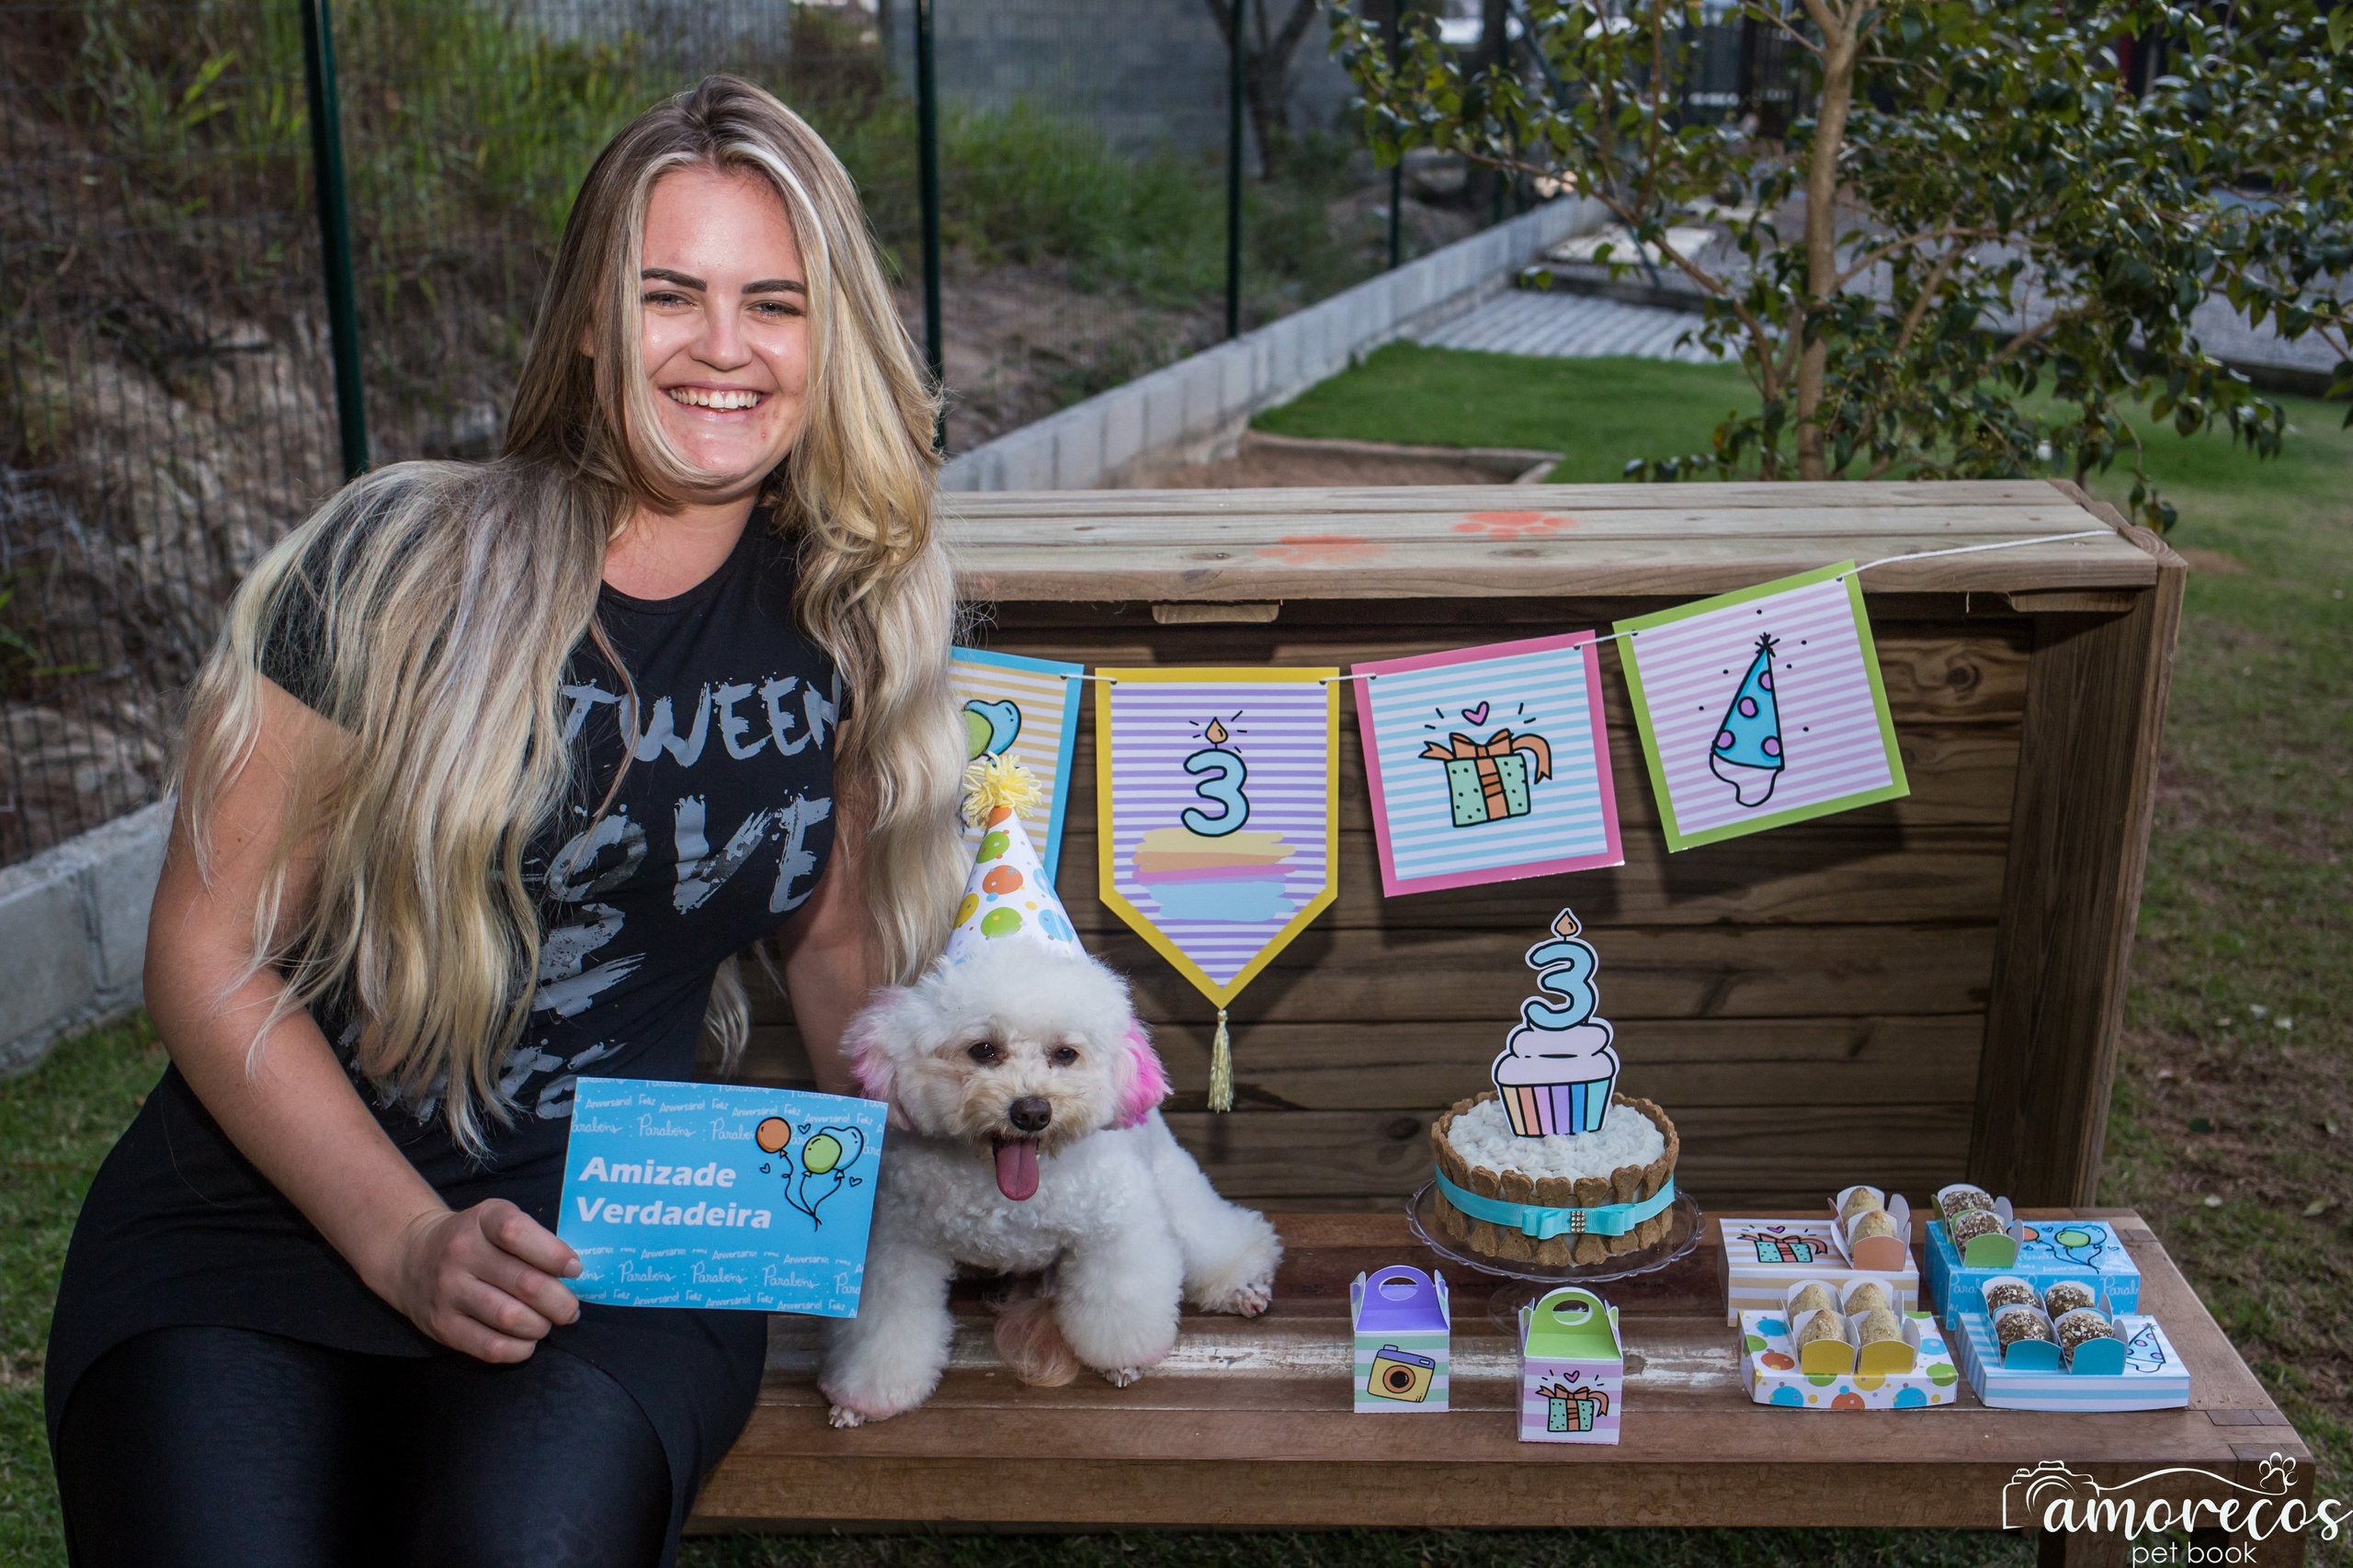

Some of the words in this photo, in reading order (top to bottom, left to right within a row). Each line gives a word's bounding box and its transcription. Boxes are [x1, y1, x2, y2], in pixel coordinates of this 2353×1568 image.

[560, 672, 838, 767] TWEEN
[1181, 748, 1250, 837] 3
[545, 787, 833, 915] OVE
[1524, 940, 1597, 1031] 3
[576, 1197, 772, 1229] Verdadeira
[578, 1156, 736, 1188] Amizade
